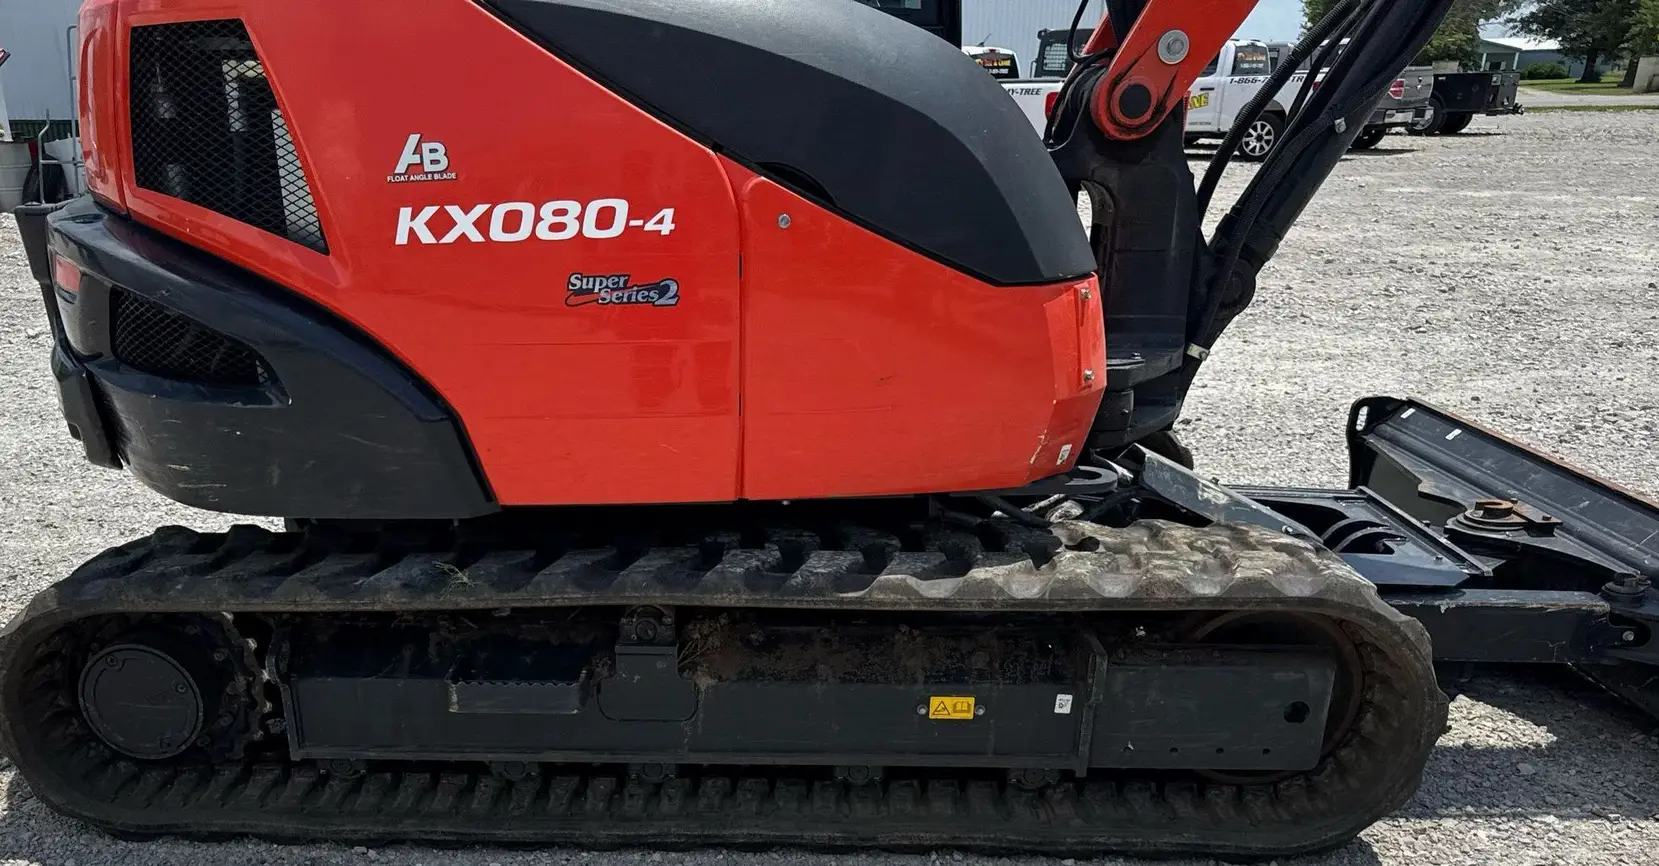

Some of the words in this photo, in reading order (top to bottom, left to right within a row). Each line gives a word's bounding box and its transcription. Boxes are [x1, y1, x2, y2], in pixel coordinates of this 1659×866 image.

[394, 133, 449, 174] AB
[387, 175, 409, 183] FLOAT
[409, 174, 433, 182] ANGLE
[433, 172, 457, 180] BLADE
[395, 198, 675, 245] KX080-4
[568, 273, 628, 293] Super
